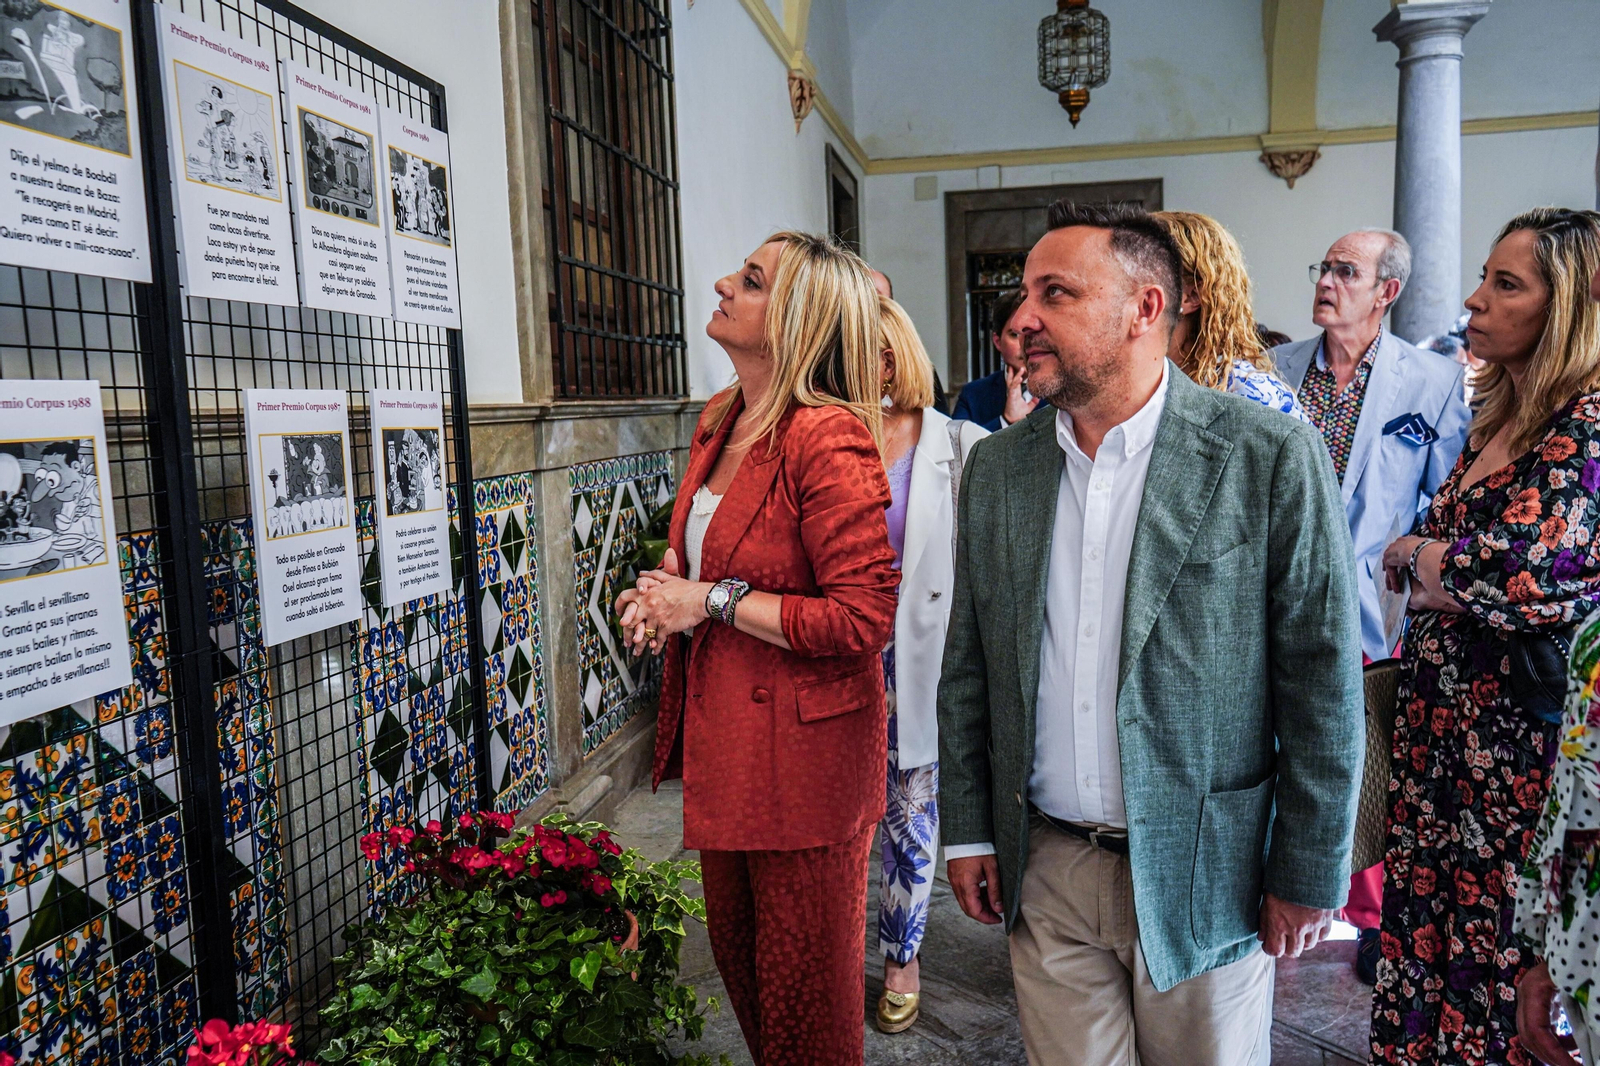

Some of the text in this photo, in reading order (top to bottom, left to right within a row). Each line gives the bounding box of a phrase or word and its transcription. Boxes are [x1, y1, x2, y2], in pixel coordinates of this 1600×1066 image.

[170, 23, 270, 72] Primer Premio Corpus 1982
[295, 75, 371, 115] Primer Premio Corpus 1981
[402, 125, 430, 143] Corpus 1980
[10, 149, 117, 184] Dijo el yelmo de Boabdil
[10, 171, 17, 180] a
[20, 173, 53, 188] nuestra
[56, 179, 81, 195] dama
[84, 185, 94, 197] de
[33, 196, 71, 212] recogeré
[75, 204, 84, 214] en
[87, 204, 120, 222] Madrid,
[207, 203, 269, 225] Fue por mandato real
[21, 213, 42, 225] pues
[46, 217, 69, 230] como
[72, 220, 81, 231] ET
[84, 223, 92, 233] sé
[209, 222, 226, 232] como
[227, 222, 242, 235] locos
[35, 232, 62, 247] volver
[65, 240, 71, 248] a
[207, 236, 275, 256] Loco estoy yo de pensar
[204, 250, 280, 272] donde puñeta hay que irse
[212, 271, 226, 281] para
[228, 273, 255, 283] encontrar
[256, 274, 261, 284] el
[26, 397, 65, 411] Corpus
[68, 397, 91, 410] 1988
[257, 402, 340, 413] Primer Premio Corpus 1987
[380, 400, 396, 409] Primer
[396, 401, 412, 409] Premio
[413, 402, 428, 411] Corpus
[276, 554, 289, 564] Todo
[297, 549, 315, 563] posible
[324, 543, 345, 555] Granada
[286, 559, 339, 577] desde Pinos Bubión
[282, 573, 342, 593] Osel alcanzó gran fama
[5, 599, 35, 617] Sevilla
[38, 596, 45, 610] el
[48, 591, 90, 608] sevillismo
[284, 586, 343, 607] al ser proclamado lama
[2, 608, 98, 638] Graná pa sus jaranas
[286, 609, 305, 622] cuando
[306, 605, 318, 616] soltó
[319, 603, 324, 612] el
[15, 644, 30, 655] sus
[32, 635, 59, 651] bailes
[61, 634, 67, 647] y
[70, 627, 98, 641] ritmos.
[6, 661, 42, 678] siempre
[44, 651, 72, 667] bailan
[74, 647, 83, 659] lo
[85, 642, 111, 656] mismo
[6, 677, 48, 698] empacho
[51, 672, 61, 685] de
[64, 658, 110, 681] sevillanas!!
